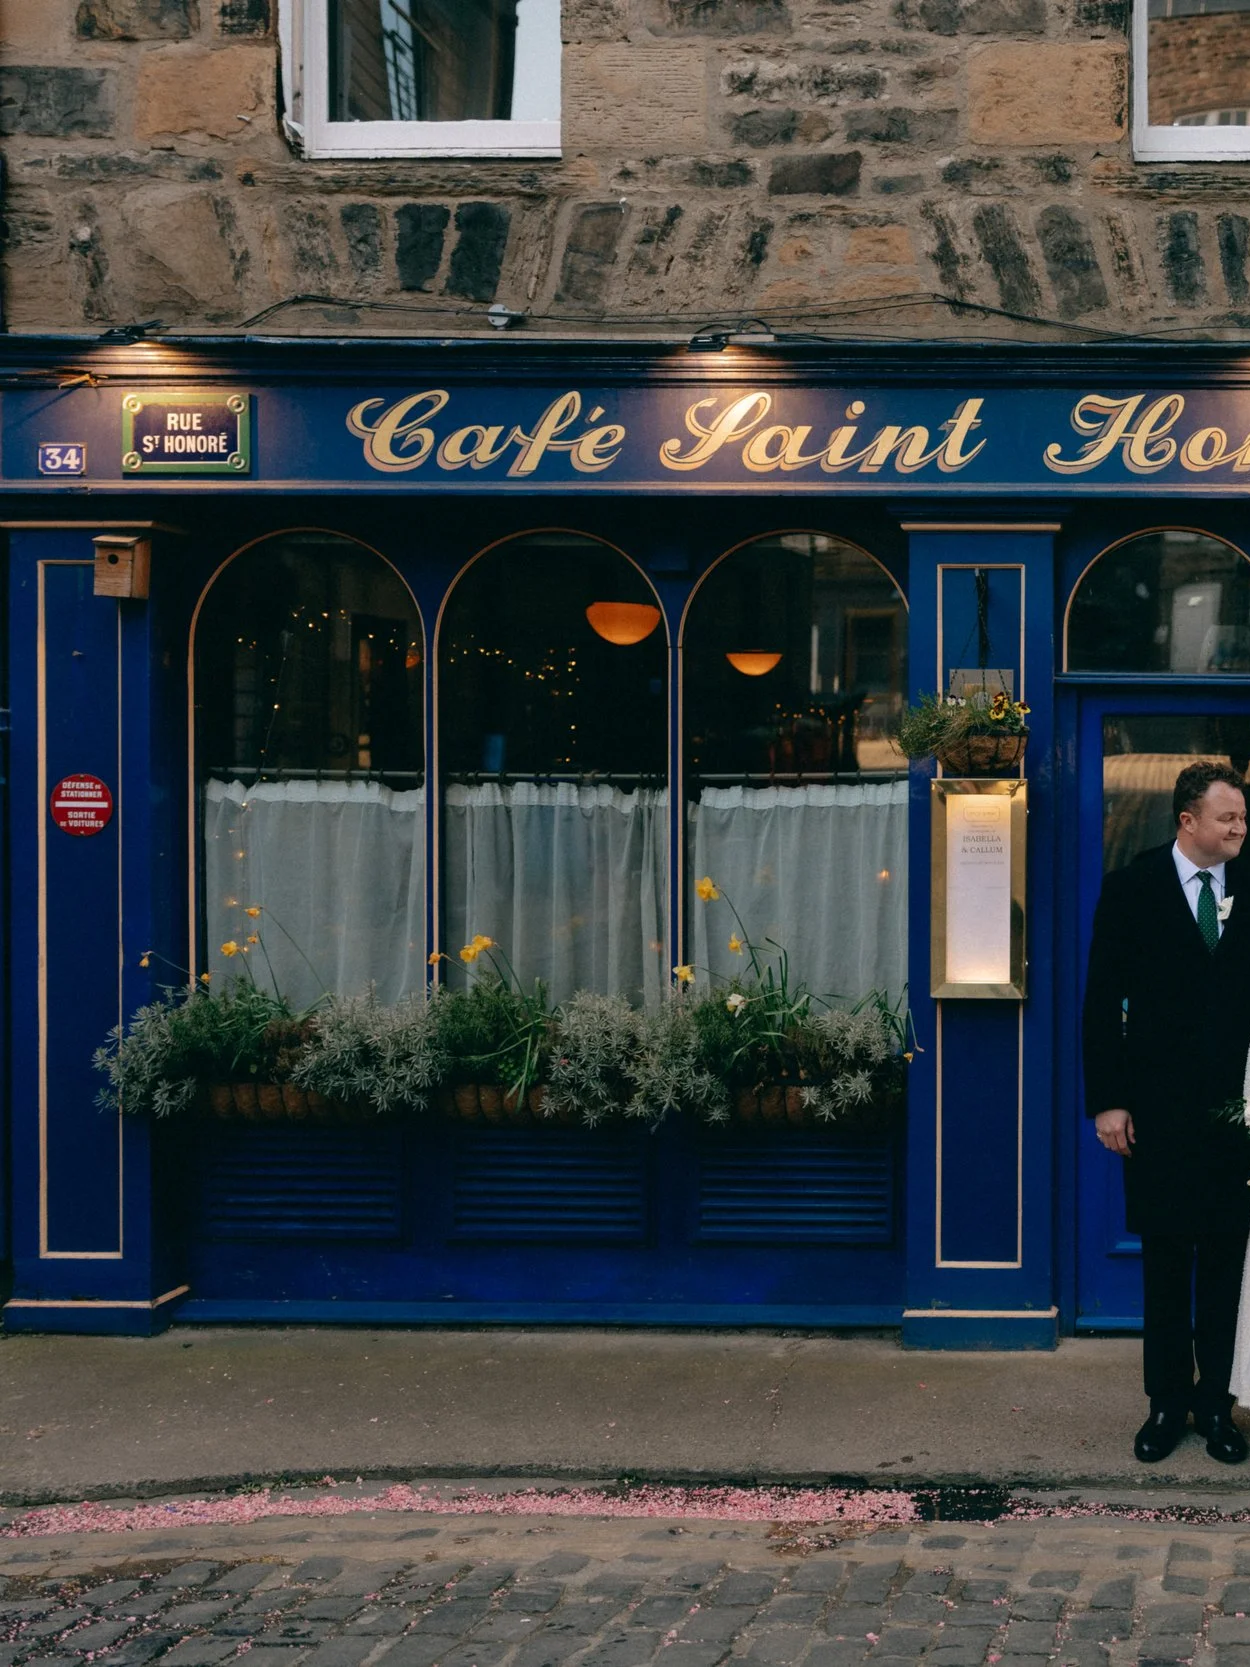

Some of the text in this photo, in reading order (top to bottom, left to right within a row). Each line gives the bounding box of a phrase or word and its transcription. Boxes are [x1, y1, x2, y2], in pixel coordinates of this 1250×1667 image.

[166, 412, 203, 431] RUE
[344, 389, 627, 478] Café
[659, 391, 988, 474] Saint
[164, 431, 228, 454] HONORÉ
[45, 447, 81, 470] 34
[62, 781, 94, 789] DÉFENSE
[60, 790, 102, 798] STATIONNER
[67, 811, 96, 819] SORTIE
[68, 819, 104, 827] VOITURES
[970, 846, 1003, 854] CALLUM
